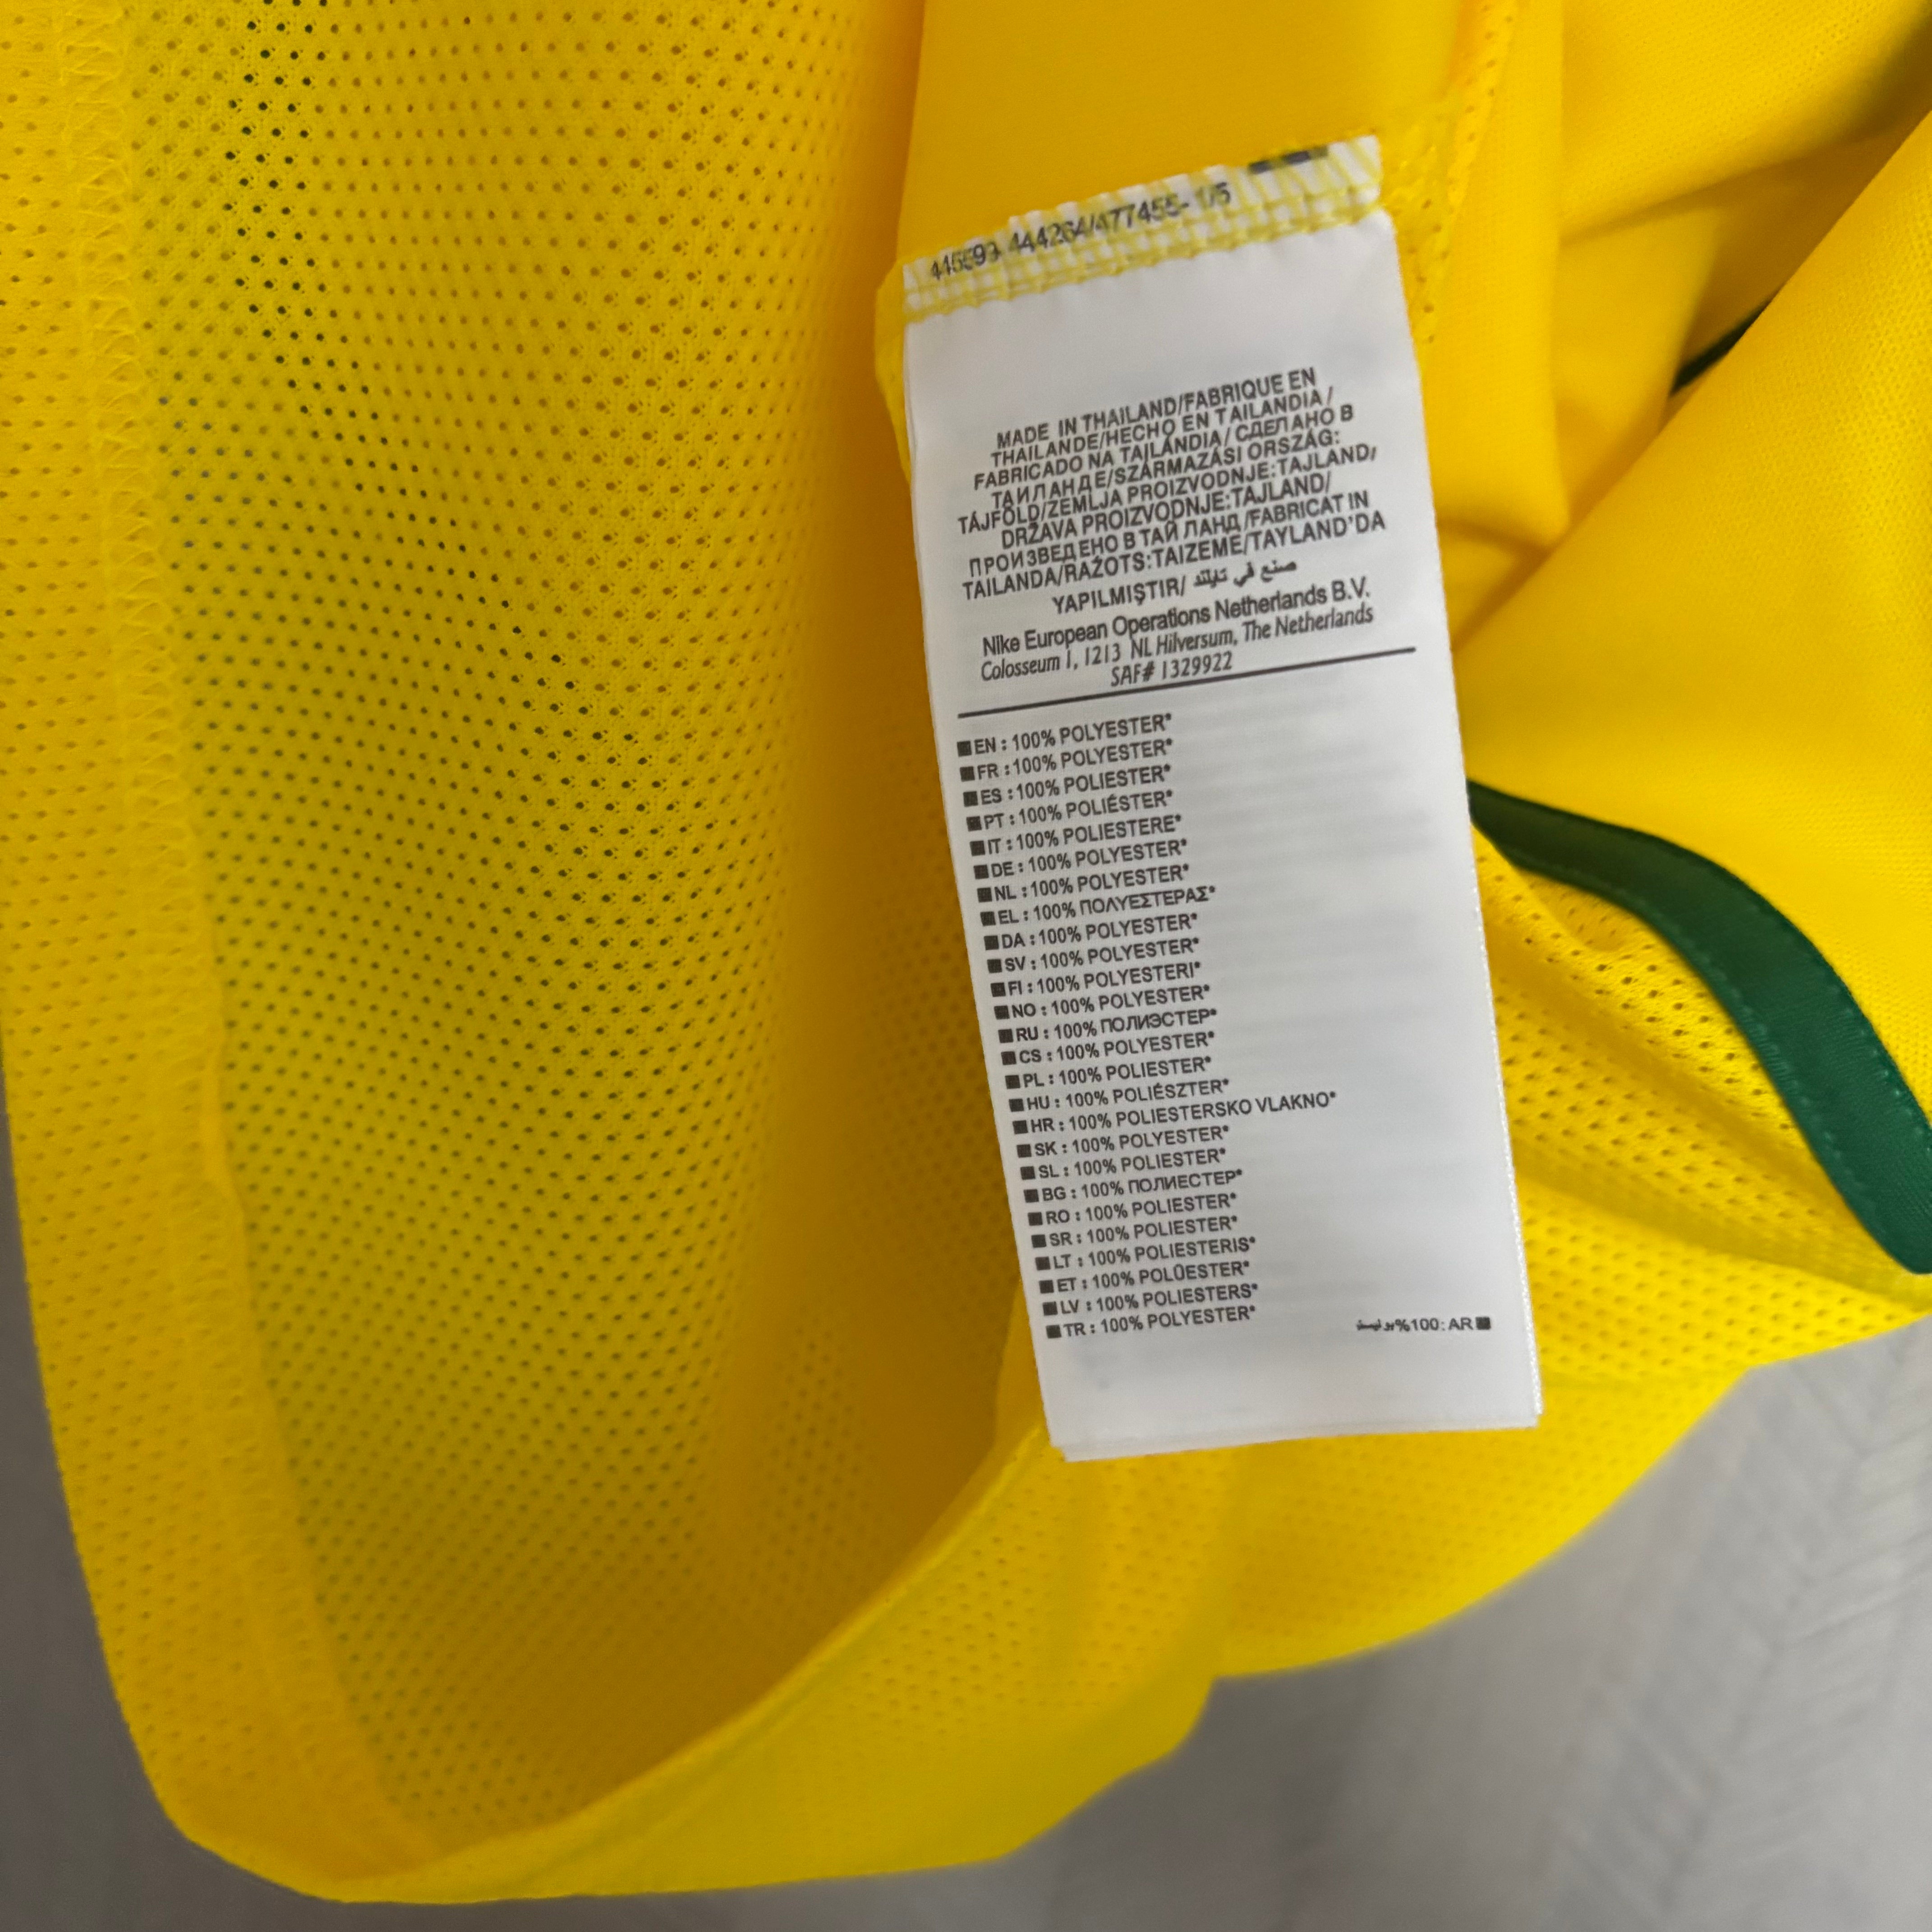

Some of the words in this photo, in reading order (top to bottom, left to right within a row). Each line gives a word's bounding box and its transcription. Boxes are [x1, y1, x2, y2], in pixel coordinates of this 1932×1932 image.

[996, 422, 1049, 450] MADE
[1058, 416, 1077, 437] IN
[1081, 373, 1284, 432] THAILAND/FABRIQUE
[1288, 367, 1316, 391] EN
[990, 419, 1176, 468] THAILANDE/HECHO
[1182, 411, 1209, 432] EN
[1247, 428, 1339, 460] ORSZÁG:
[974, 455, 1083, 491] FABRICADO
[1088, 451, 1114, 469] NA
[1348, 490, 1369, 510] IN
[1001, 518, 1077, 550] DRŽAVA
[1233, 561, 1255, 588] في
[1260, 559, 1297, 583] صنع
[982, 634, 1021, 658] Nike
[1024, 622, 1108, 651] European
[1112, 607, 1211, 639] Operations
[1214, 584, 1328, 621] Netherlands
[1331, 575, 1370, 602] B.V.
[980, 656, 1061, 682] Colosseum
[1085, 642, 1121, 666] 1213
[1129, 637, 1152, 659] NL
[1156, 630, 1238, 655] Hilversum,
[1242, 619, 1272, 642] The
[1274, 601, 1374, 637] Netherlands
[1110, 660, 1155, 687] SAF#
[1162, 650, 1233, 680] 1329922
[1012, 728, 1057, 751] 100%
[1012, 753, 1057, 775] 100%
[1016, 778, 1060, 800] 100%
[1018, 804, 1063, 825] 100%
[1016, 829, 1059, 851] 100%
[1028, 852, 1072, 873] 100%
[1030, 877, 1074, 897] 100%
[1033, 901, 1076, 921] 100%
[1038, 925, 1082, 945] 100%
[1040, 949, 1084, 969] 100%
[1036, 974, 1081, 994] 100%
[1051, 996, 1095, 1016] 100%
[1053, 1020, 1098, 1040] 100%
[1056, 1042, 1100, 1061] 100%
[1058, 1066, 1103, 1086] 100%
[1065, 1090, 1109, 1108] 100%
[1068, 1112, 1113, 1131] 100%
[1115, 1098, 1252, 1127] POLIESTERSKO
[1072, 1135, 1115, 1154] 100%
[1074, 1158, 1117, 1176] 100%
[1081, 1180, 1125, 1199] 100%
[1085, 1202, 1128, 1222] 100%
[1086, 1225, 1130, 1244] 100%
[1088, 1247, 1131, 1267] 100%
[1092, 1270, 1135, 1289] 100%
[1096, 1294, 1140, 1312] 100%
[1100, 1315, 1144, 1334] 100%
